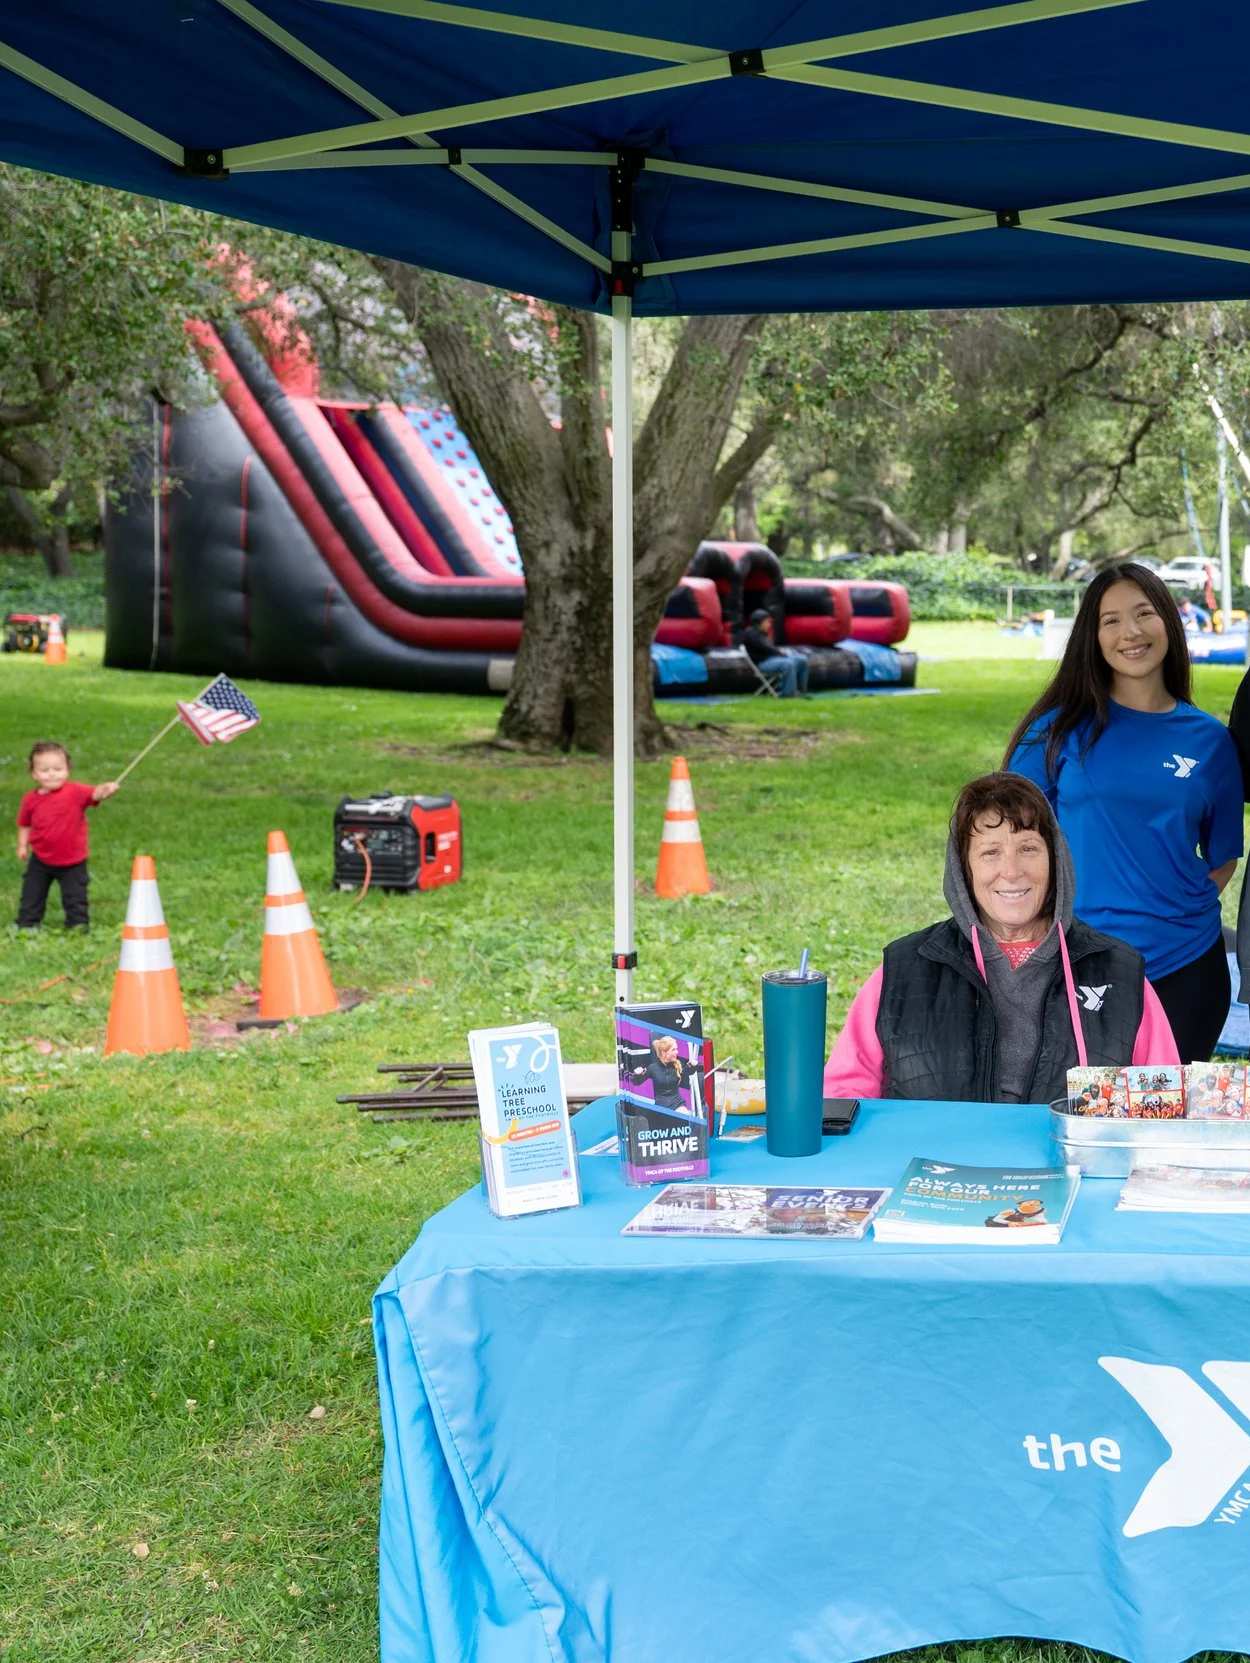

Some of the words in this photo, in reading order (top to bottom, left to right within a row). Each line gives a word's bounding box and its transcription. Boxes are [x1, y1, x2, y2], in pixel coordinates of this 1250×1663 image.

[1162, 761, 1176, 769] the
[501, 1084, 547, 1098] LEARNING
[502, 1097, 526, 1108] TREE
[503, 1103, 557, 1118] PRESCHOOL
[637, 1128, 669, 1141] GROW
[670, 1125, 692, 1138] AND
[637, 1136, 699, 1158] THRIVE
[908, 1181, 944, 1191] FOR
[950, 1187, 991, 1196] OUR
[910, 1176, 988, 1190] ALWAYS
[775, 1194, 870, 1204] SENIOR
[905, 1187, 1024, 1201] COMMUNITY
[1022, 1433, 1122, 1473] the
